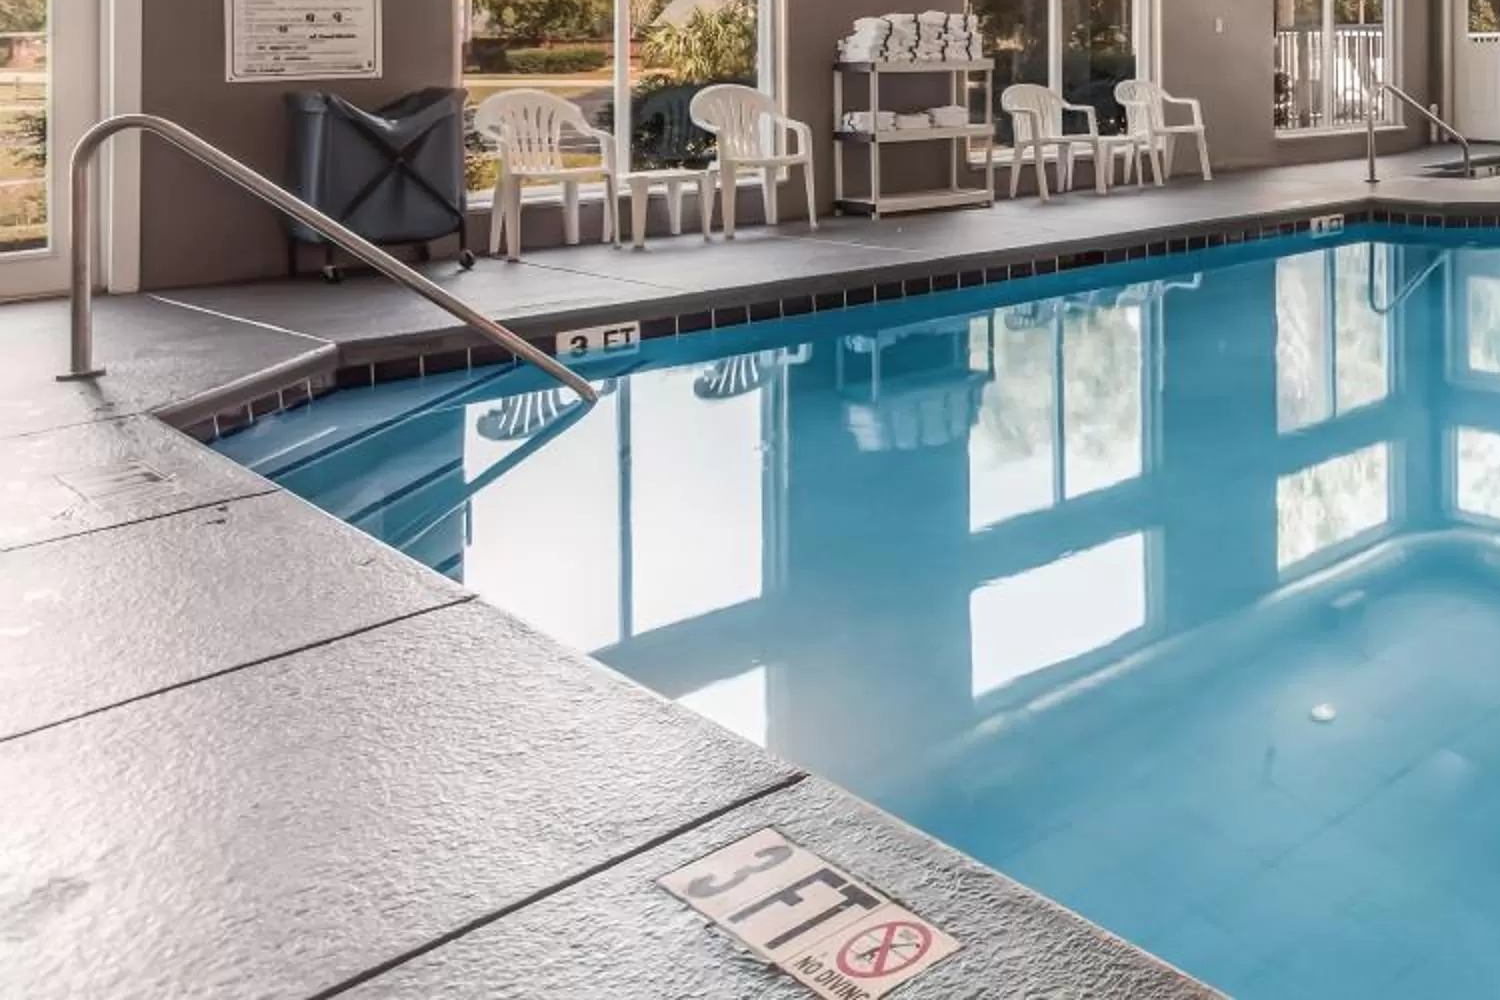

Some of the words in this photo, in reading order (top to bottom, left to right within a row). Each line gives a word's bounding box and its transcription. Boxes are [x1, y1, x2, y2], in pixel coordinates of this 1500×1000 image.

[603, 327, 636, 348] FT
[686, 845, 794, 899] 3
[727, 867, 882, 951] FT
[792, 955, 824, 975] NO
